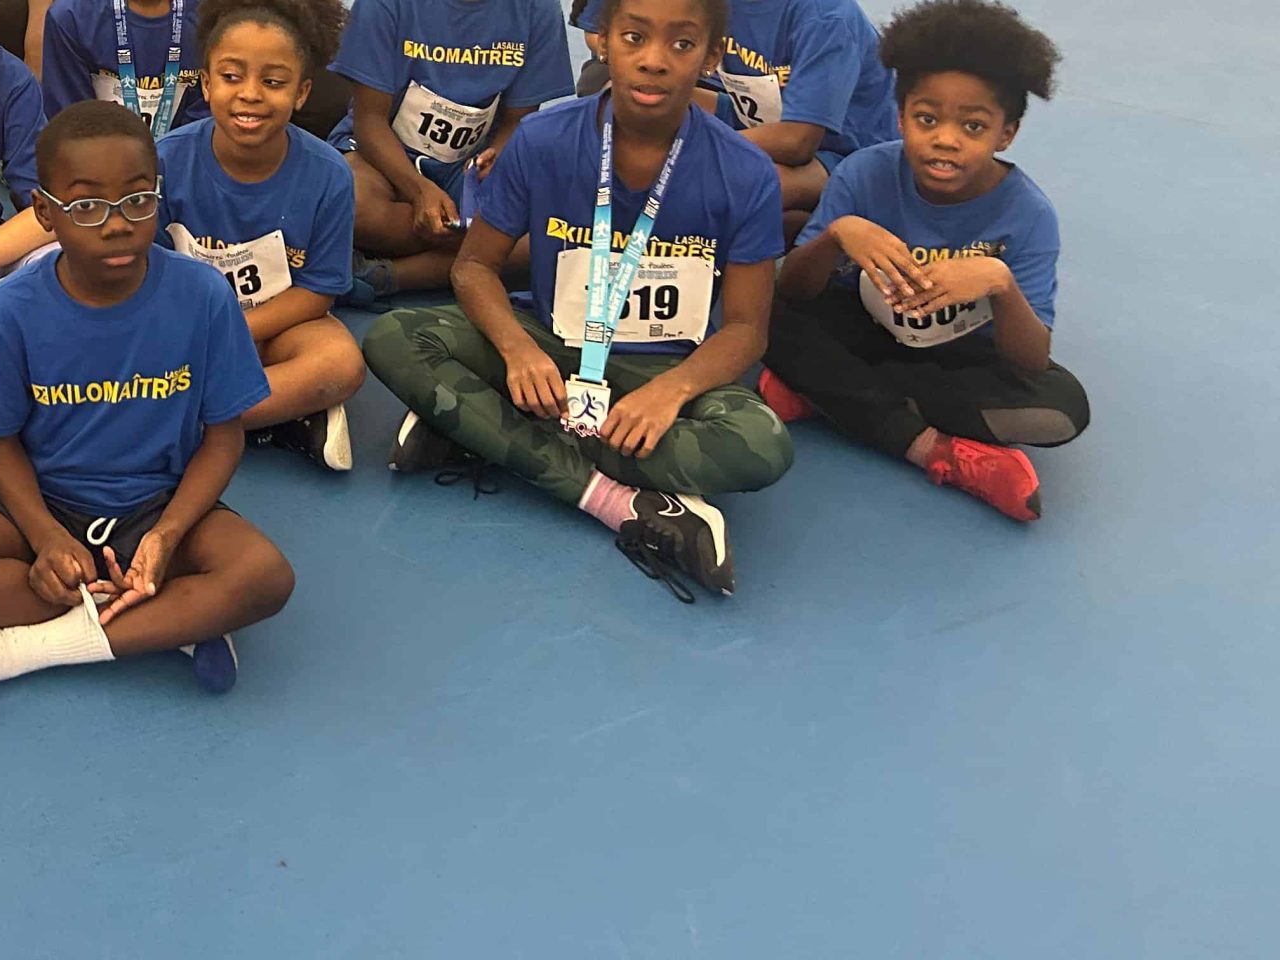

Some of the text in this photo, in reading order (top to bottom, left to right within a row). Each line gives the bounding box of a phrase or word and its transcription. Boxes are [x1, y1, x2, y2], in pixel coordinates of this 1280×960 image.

[492, 41, 525, 51] LASALLE
[417, 112, 487, 150] 1303
[565, 226, 716, 264] KILMÎTRES
[675, 235, 717, 248] LASALLE
[225, 264, 261, 296] 13
[50, 371, 192, 406] KILOMAÎTRES
